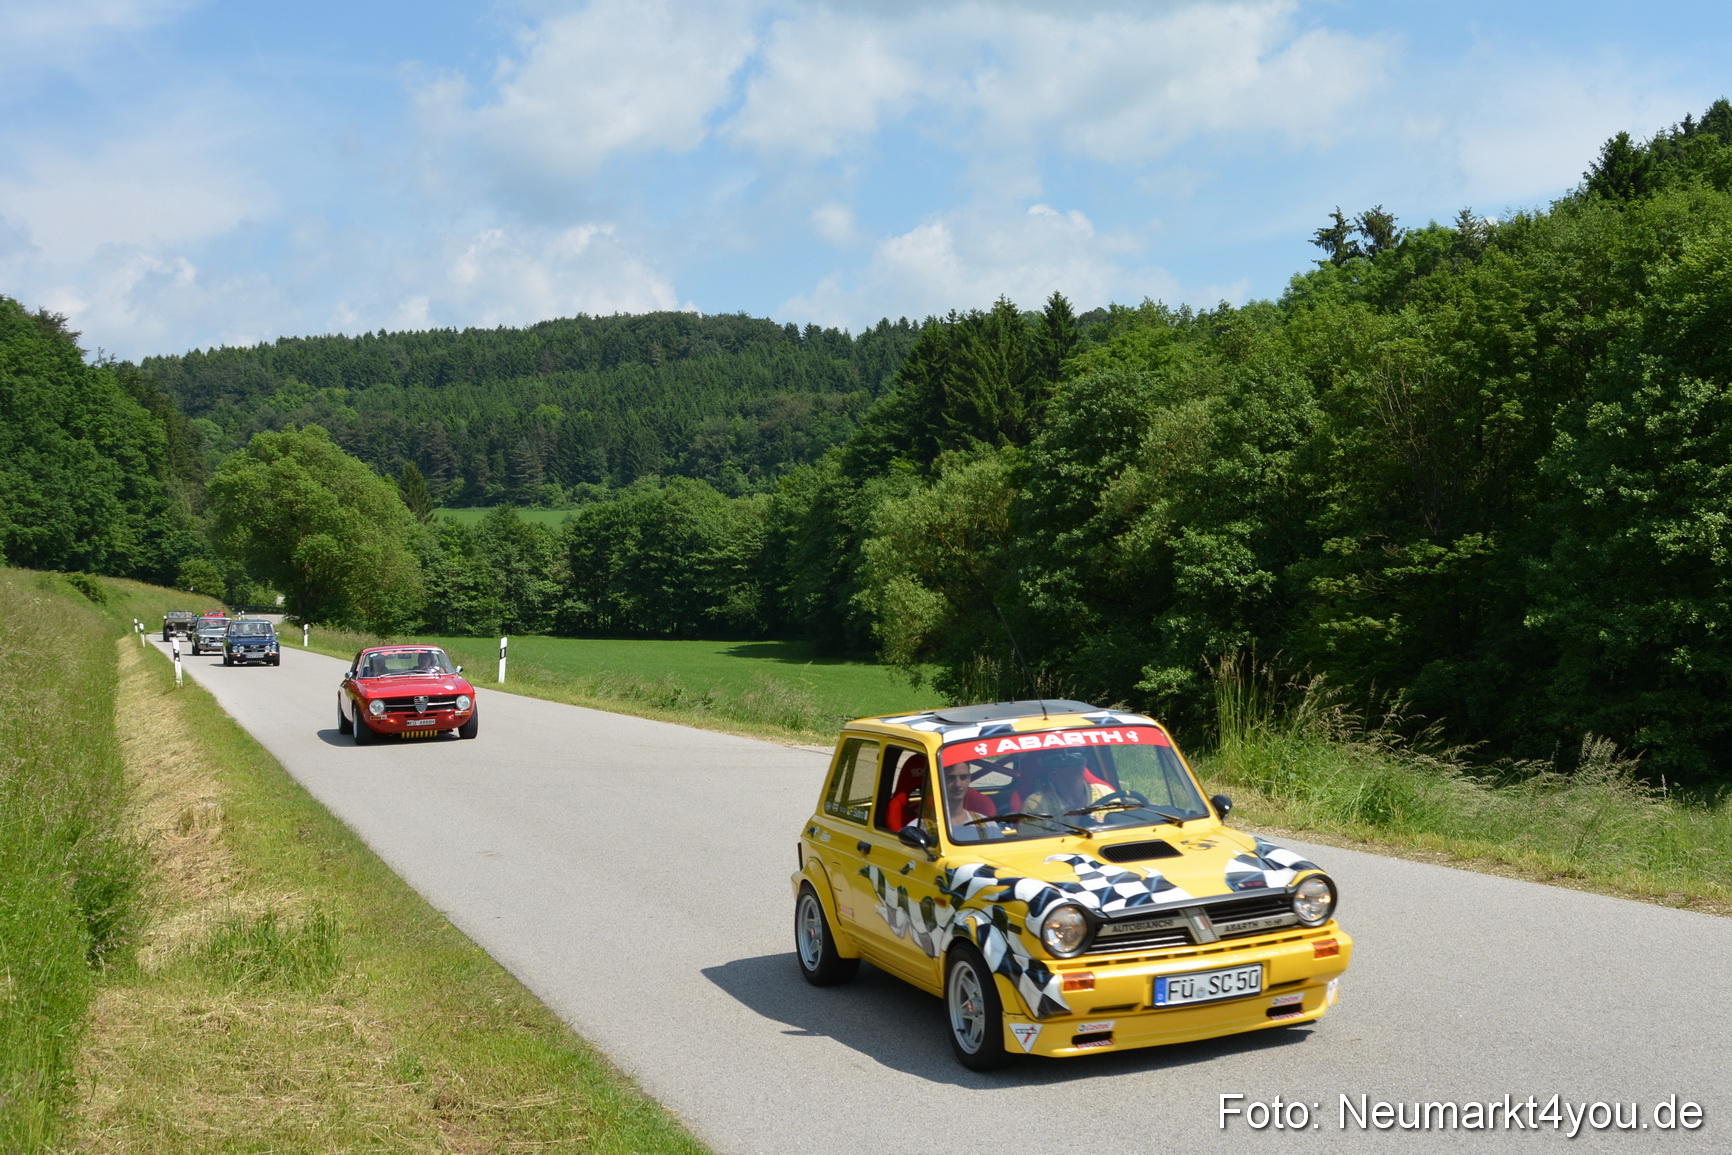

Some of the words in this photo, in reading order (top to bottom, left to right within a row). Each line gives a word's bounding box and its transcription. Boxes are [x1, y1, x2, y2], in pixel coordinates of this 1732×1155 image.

[996, 730, 1124, 753] ABARTH
[1111, 918, 1174, 934] AUTOBIANCHI
[1224, 921, 1259, 933] ABARTH
[1168, 979, 1195, 1001] FÜ
[1208, 973, 1233, 995] SC
[1236, 969, 1259, 991] 50
